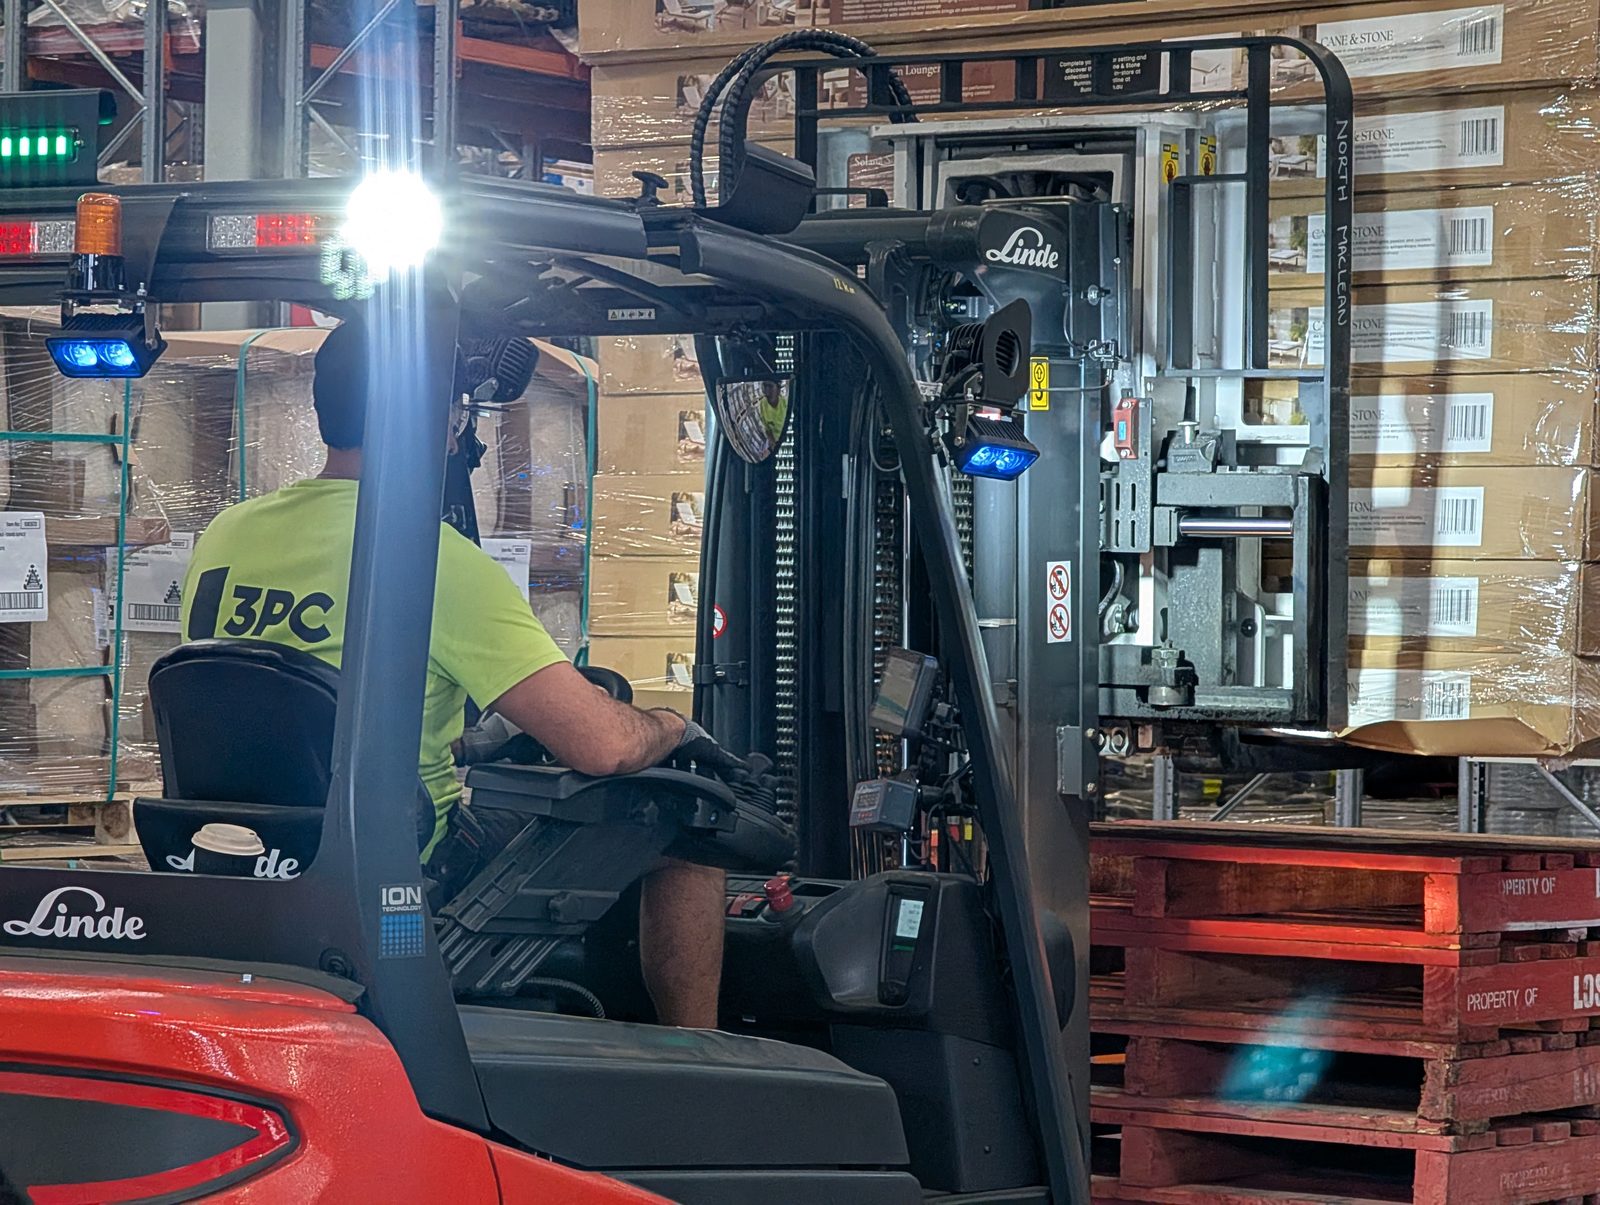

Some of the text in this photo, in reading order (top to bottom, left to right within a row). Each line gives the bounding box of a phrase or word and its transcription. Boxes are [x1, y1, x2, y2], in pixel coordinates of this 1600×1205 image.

[1320, 30, 1393, 48] CANE & STONE
[1361, 128, 1394, 141] STONE
[1336, 120, 1348, 325] NORTH MACLEAN
[1353, 226, 1384, 238] STONE
[986, 226, 1058, 268] Linde
[1352, 318, 1384, 330] STONE
[1352, 409, 1384, 421] STONE
[1350, 501, 1376, 513] TONE
[1541, 877, 1556, 894] OF
[382, 886, 421, 905] ION
[3, 886, 147, 940] Linde
[1467, 989, 1519, 1012] PROPERTY
[1524, 987, 1538, 1007] OF
